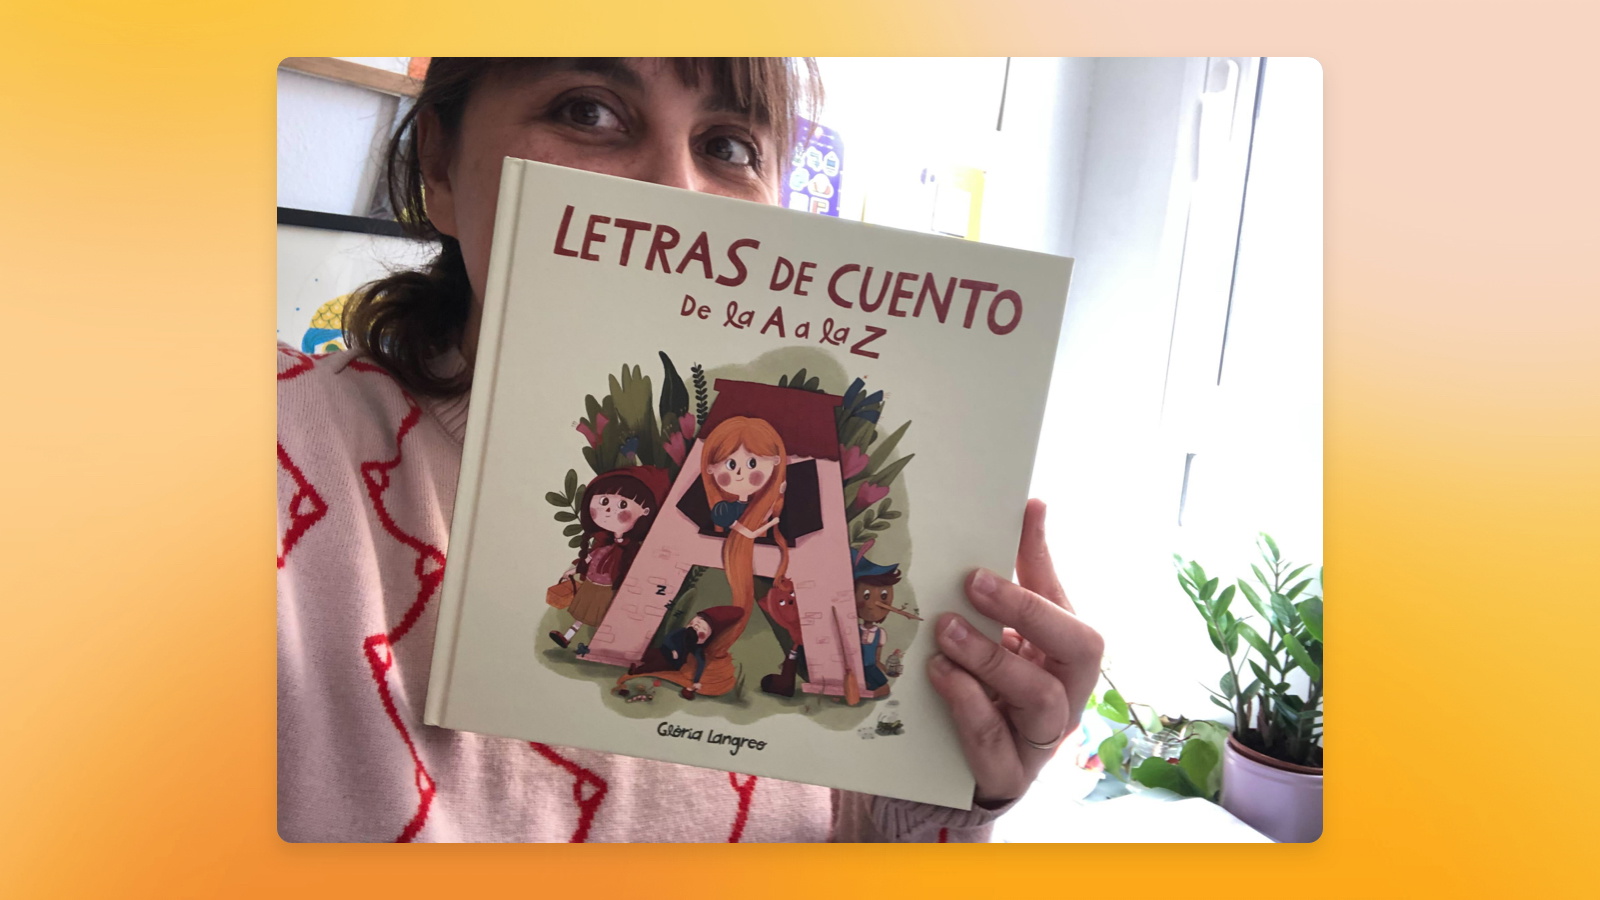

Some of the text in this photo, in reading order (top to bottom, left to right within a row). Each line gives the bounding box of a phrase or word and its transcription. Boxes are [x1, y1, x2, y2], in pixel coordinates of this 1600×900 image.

[554, 205, 1022, 336] LETRAS DE CUENTO
[680, 294, 888, 360] De la A a la Z
[707, 730, 767, 755] Langreo
